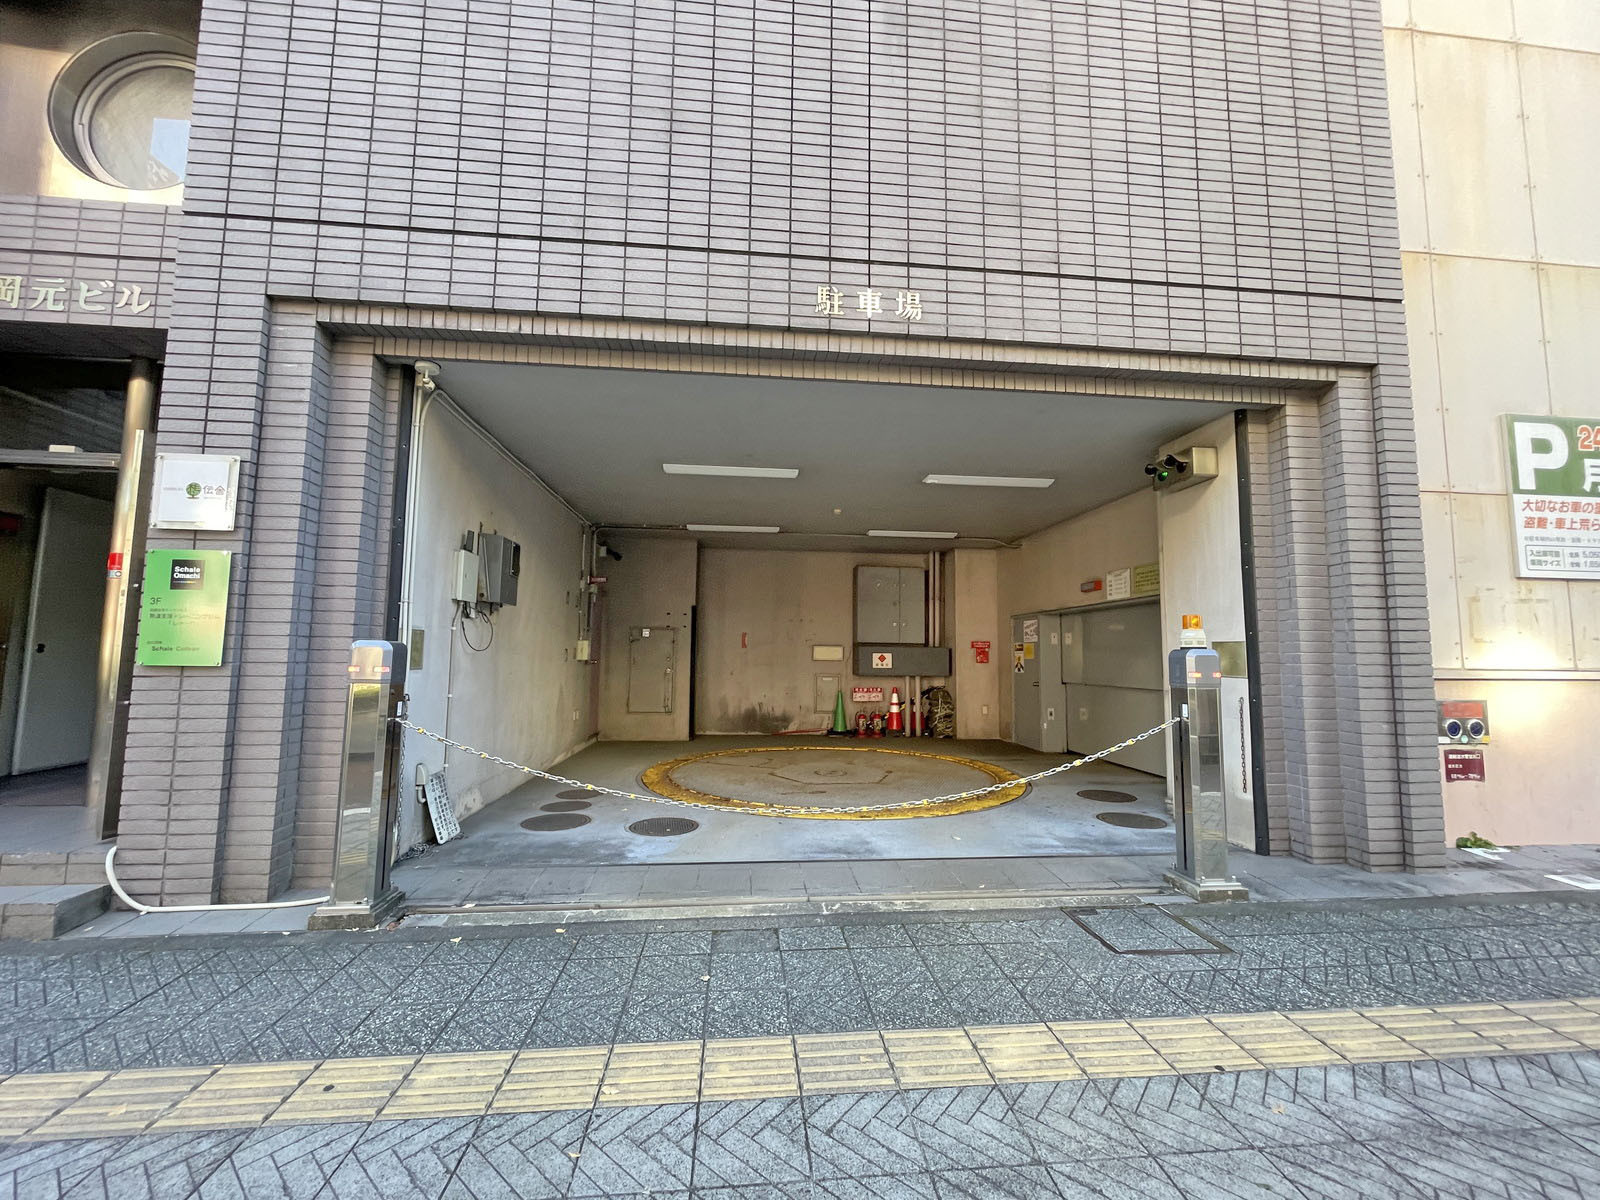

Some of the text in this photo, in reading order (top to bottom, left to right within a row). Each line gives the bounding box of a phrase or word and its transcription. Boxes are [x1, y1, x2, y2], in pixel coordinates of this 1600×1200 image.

[814, 285, 923, 321] 駐車場
[1513, 421, 1569, 490] P
